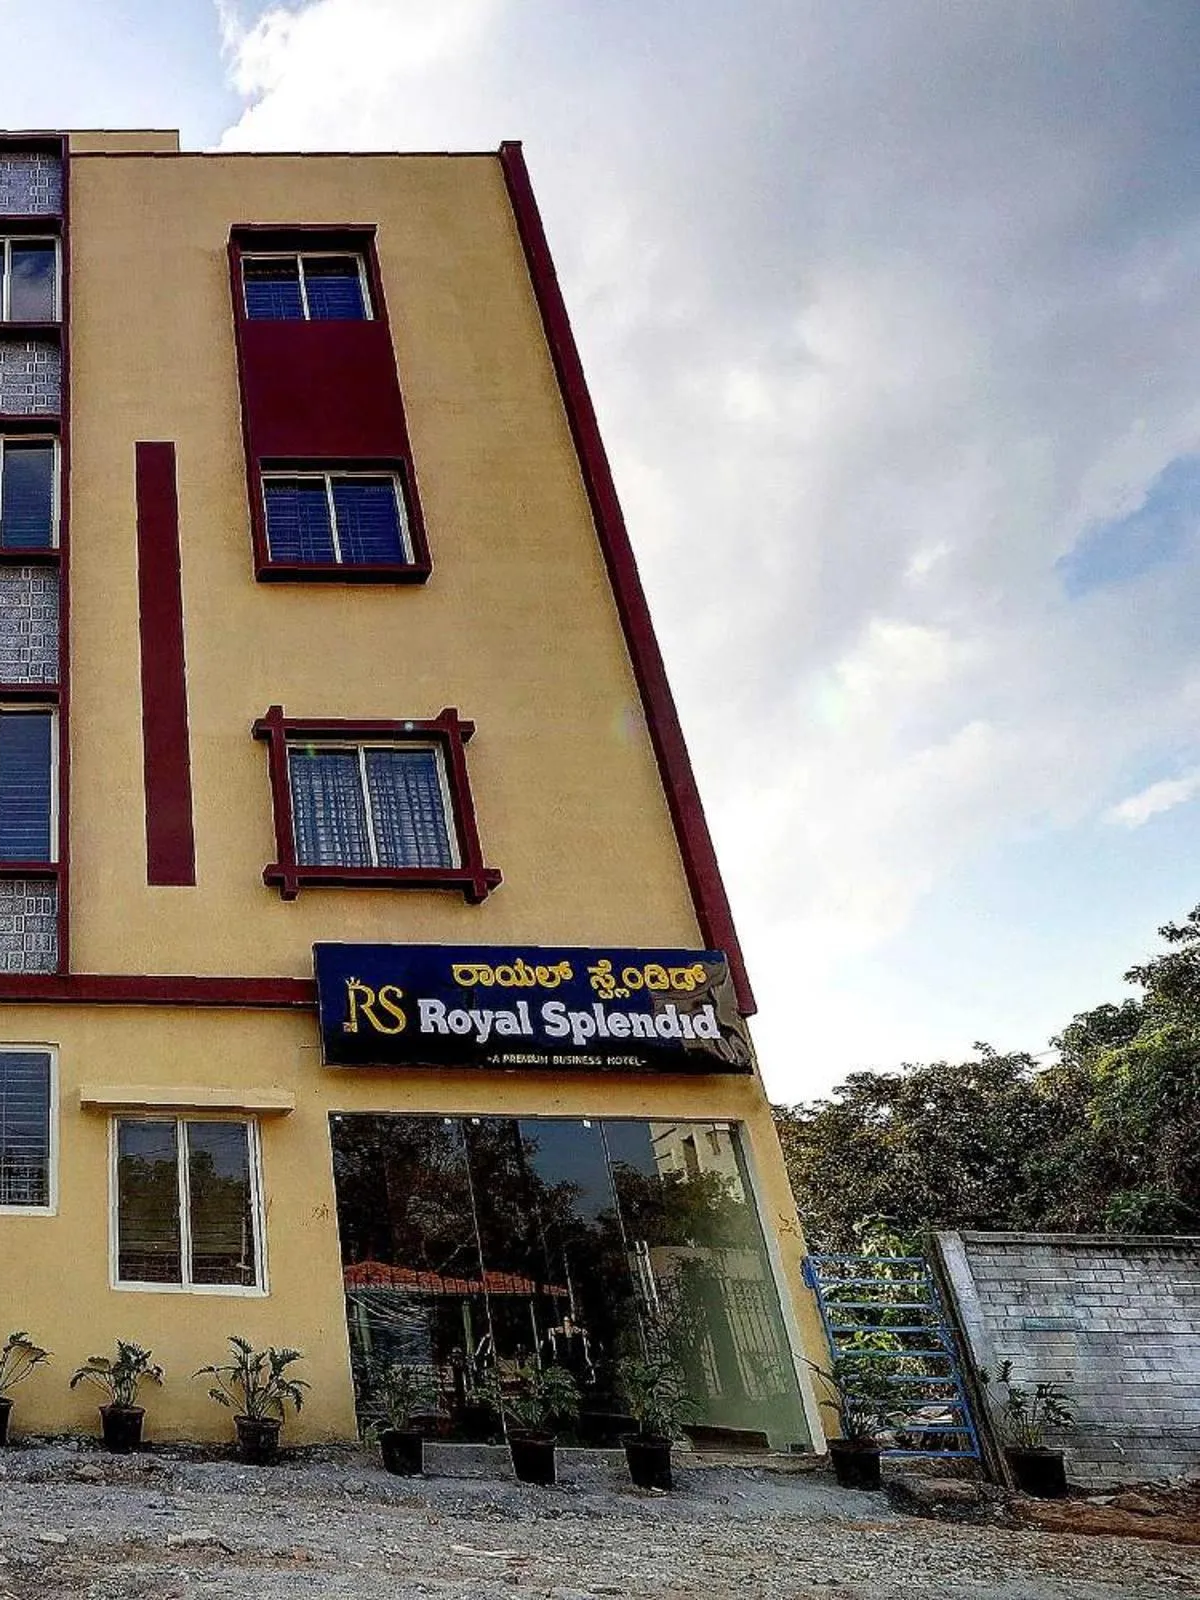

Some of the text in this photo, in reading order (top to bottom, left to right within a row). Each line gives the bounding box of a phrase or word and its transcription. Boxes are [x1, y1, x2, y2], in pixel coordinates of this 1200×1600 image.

[343, 980, 407, 1034] RS
[417, 998, 722, 1045] Royal Splendid
[502, 1054, 548, 1065] PREMIUM
[552, 1055, 602, 1065] BUSINESS
